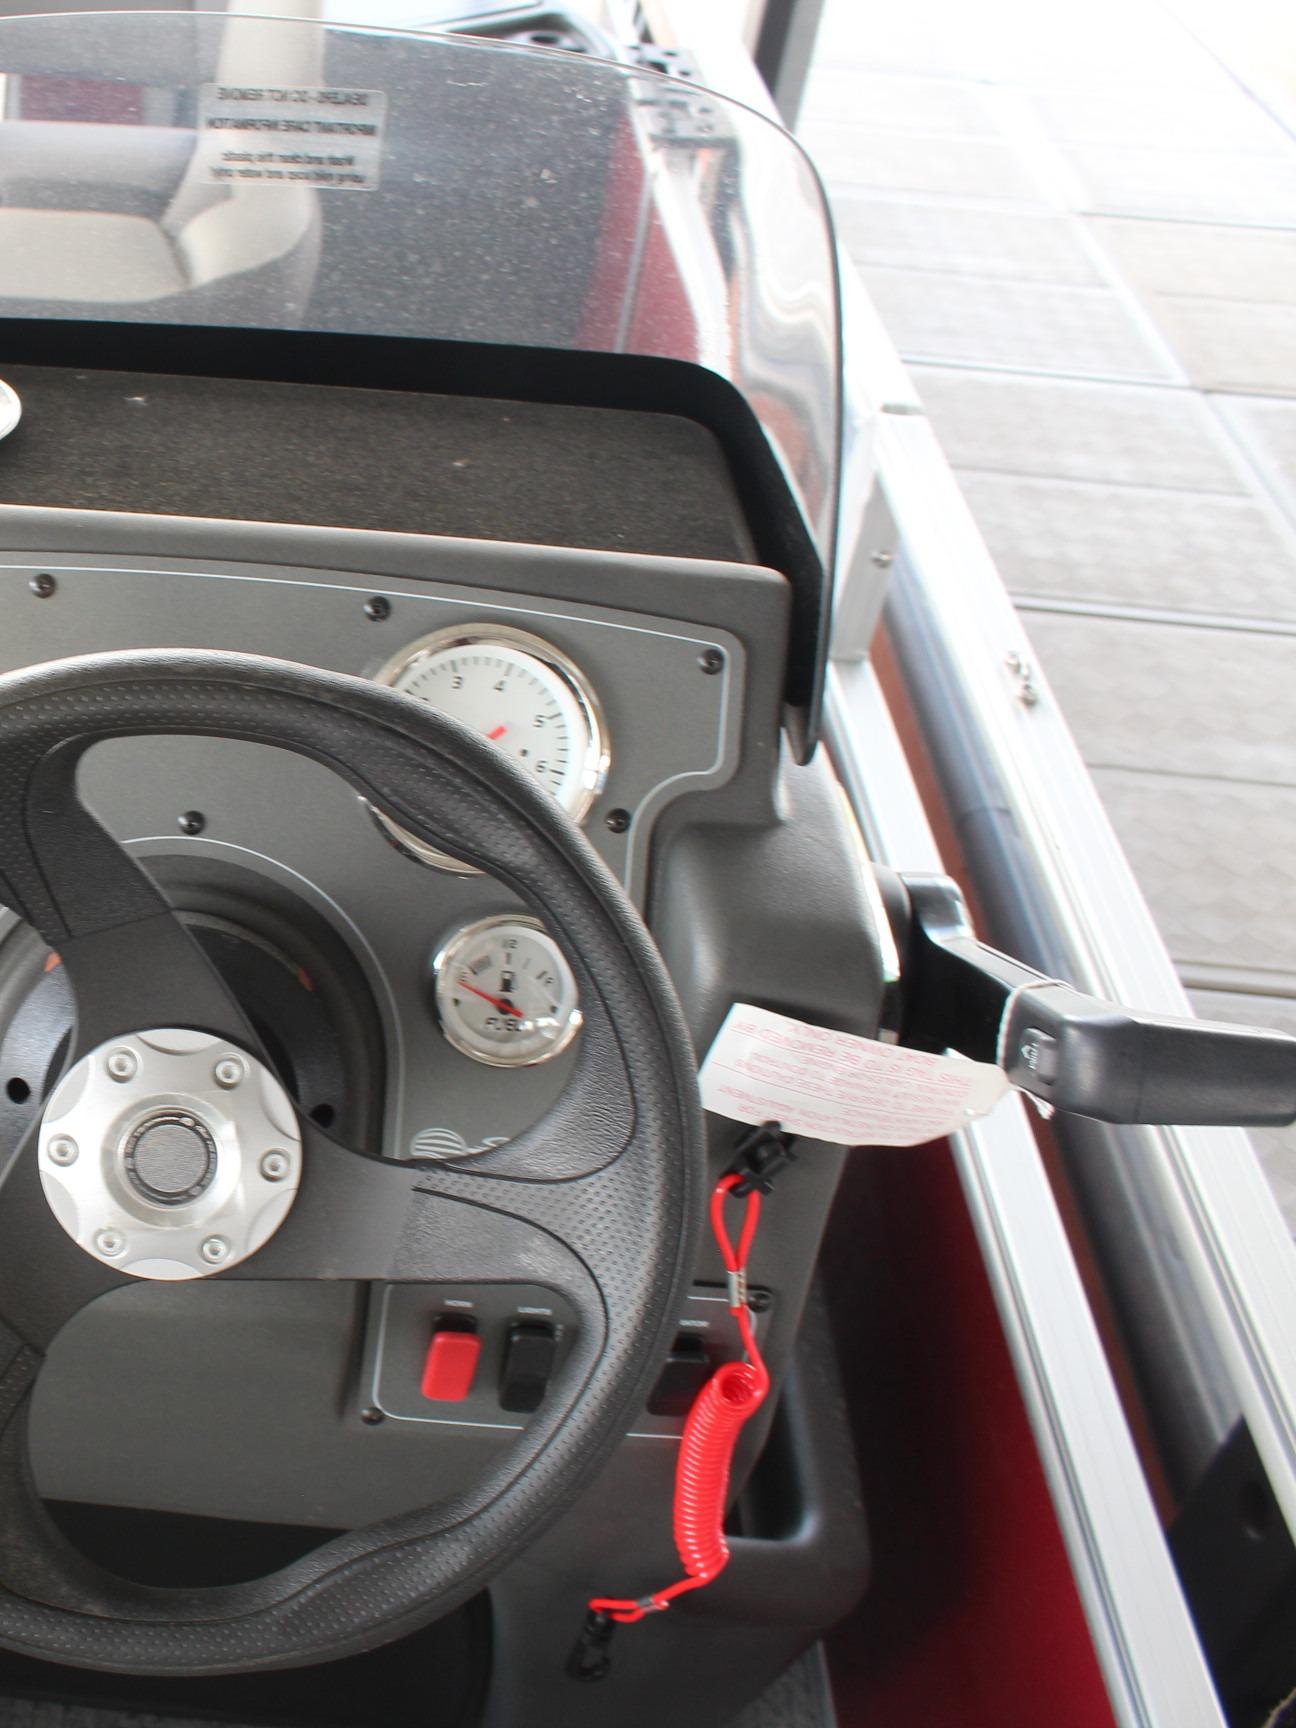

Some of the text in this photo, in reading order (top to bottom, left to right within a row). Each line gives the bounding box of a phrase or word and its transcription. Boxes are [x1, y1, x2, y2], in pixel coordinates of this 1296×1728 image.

[451, 675, 463, 689] 3
[493, 680, 505, 691] 4
[533, 714, 545, 728] 5
[536, 760, 548, 773] 6
[485, 1016, 523, 1032] FUEL
